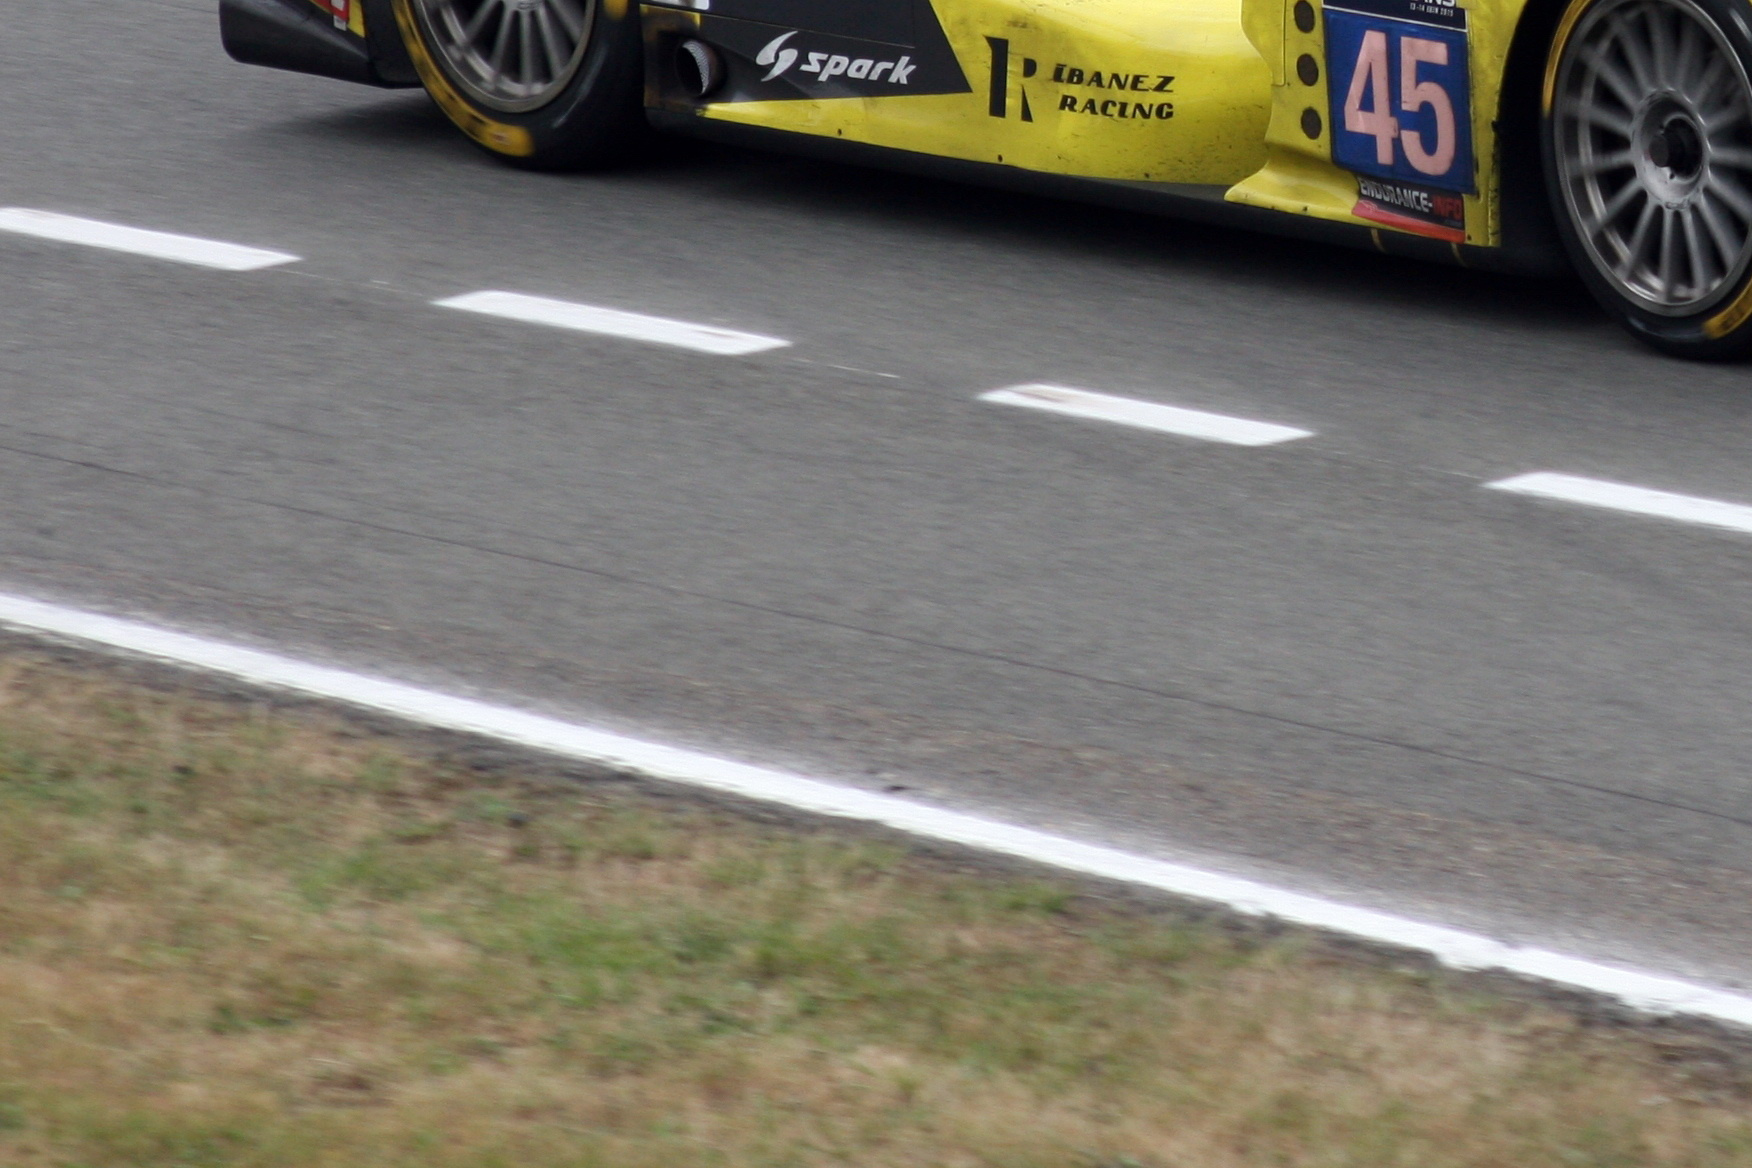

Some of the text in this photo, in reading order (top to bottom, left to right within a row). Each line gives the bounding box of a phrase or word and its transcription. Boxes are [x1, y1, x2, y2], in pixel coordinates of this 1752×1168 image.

[799, 51, 917, 85] spark
[1052, 63, 1175, 93] IBANEZ
[1058, 94, 1174, 120] RACING
[1344, 30, 1456, 176] 45
